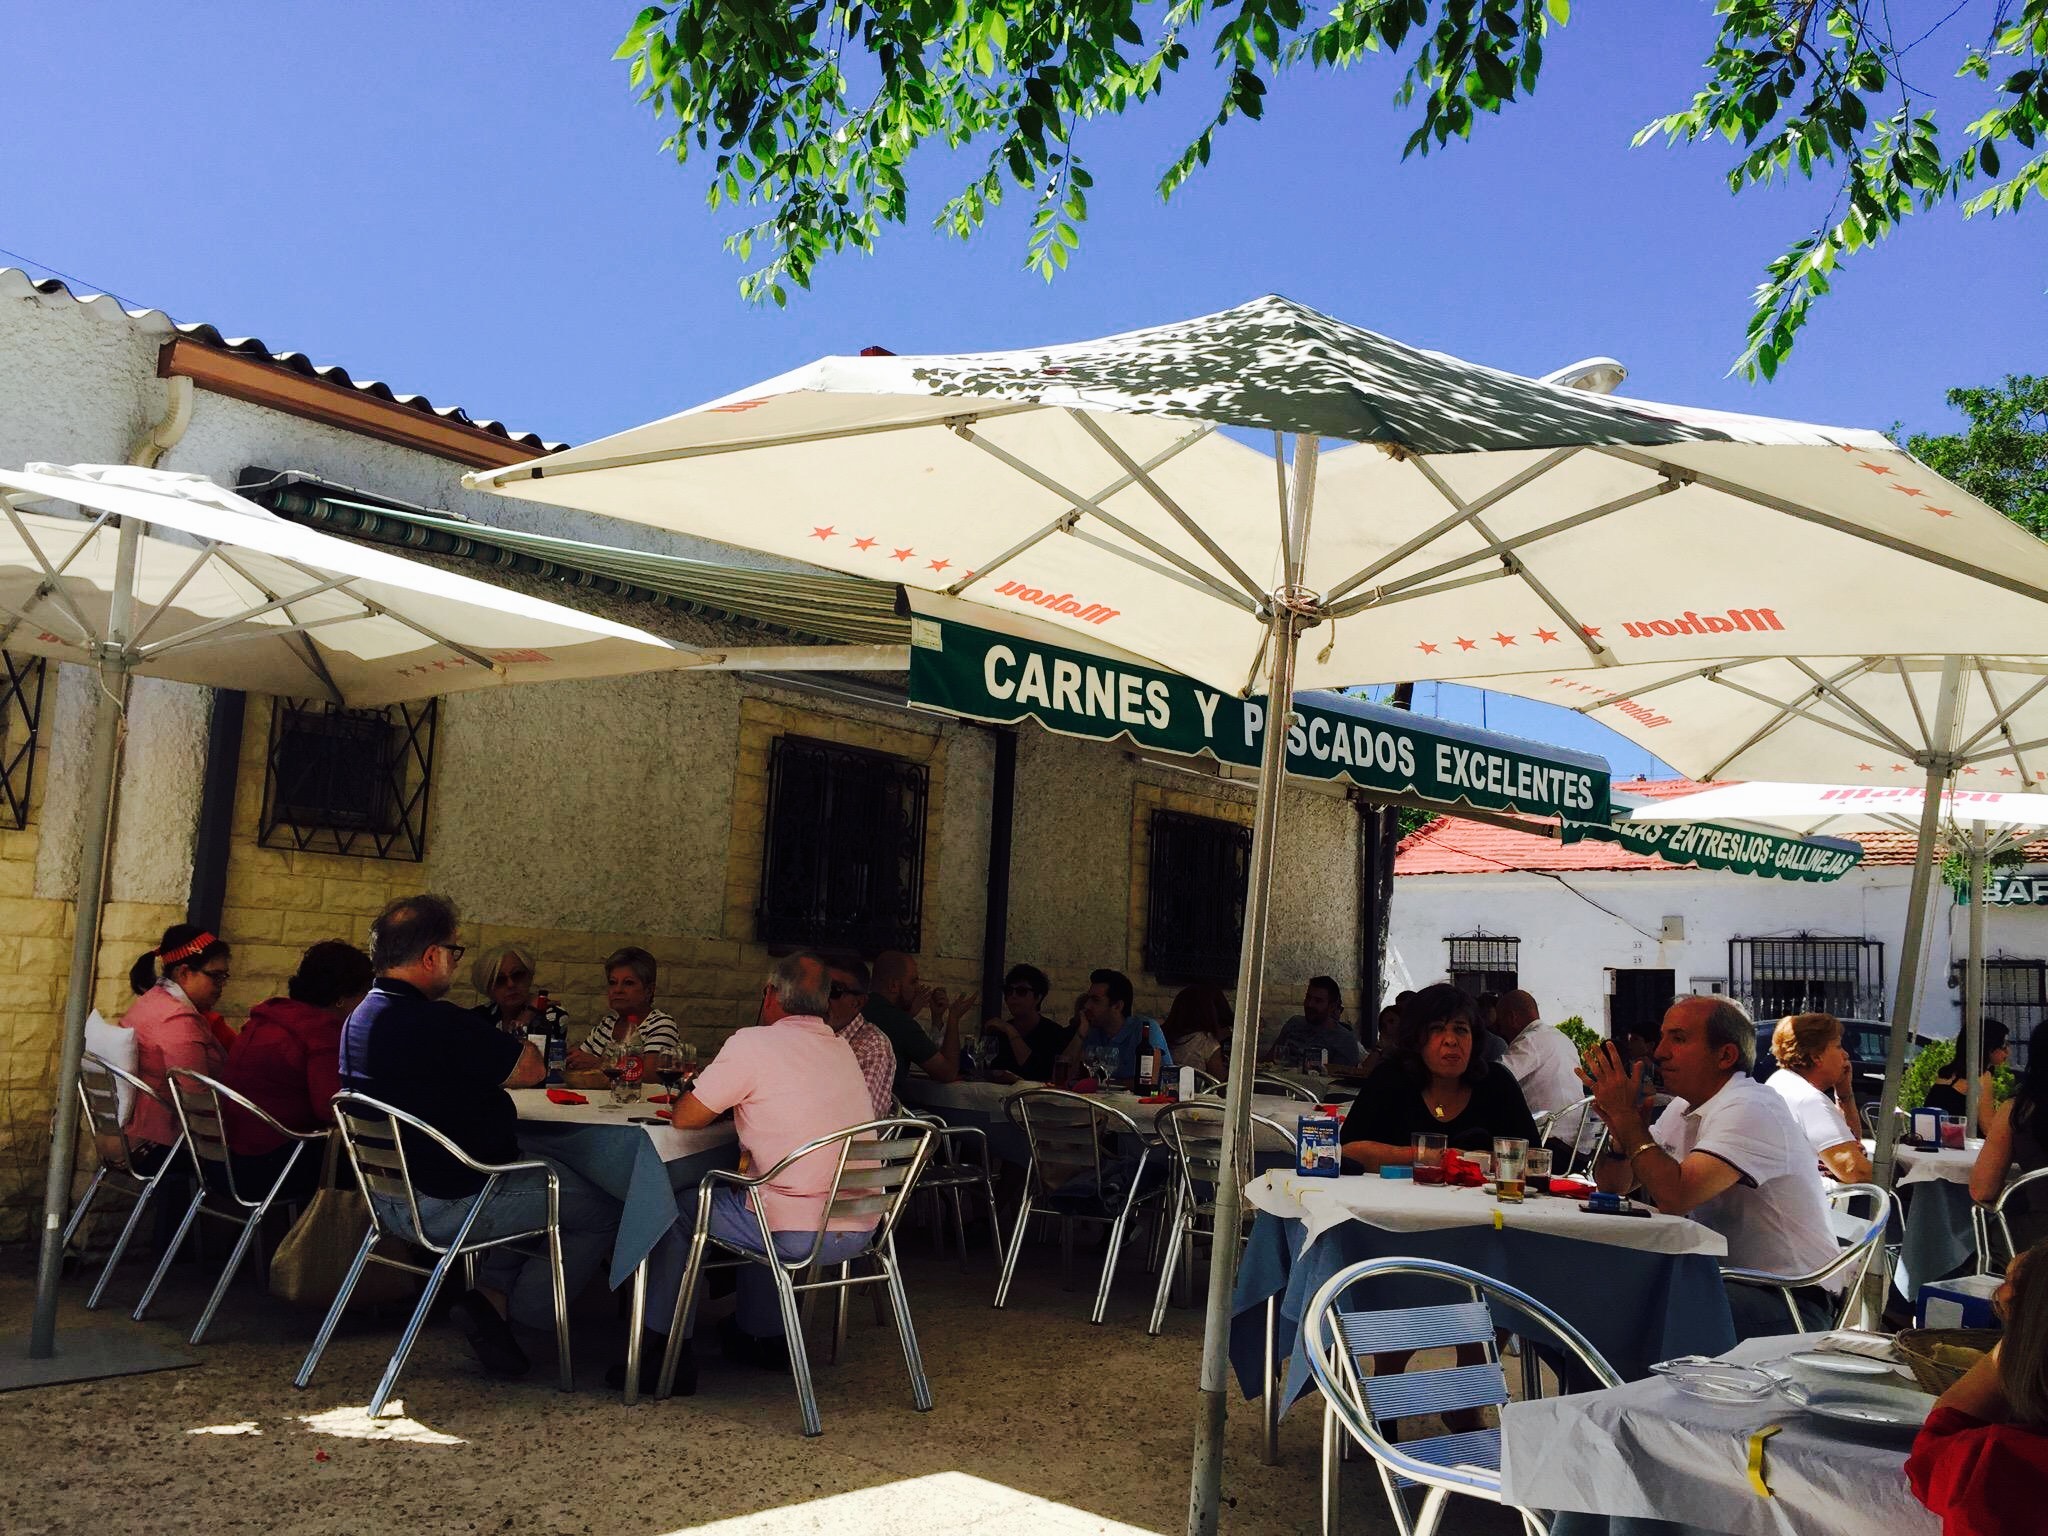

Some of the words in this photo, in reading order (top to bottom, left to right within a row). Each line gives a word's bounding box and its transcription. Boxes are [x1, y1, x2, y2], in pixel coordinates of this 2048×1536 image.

[984, 644, 1171, 730] CARNES
[1194, 689, 1221, 738] Y
[1243, 702, 1416, 778] PSCADOS
[1436, 743, 1594, 810] EXCELENTES
